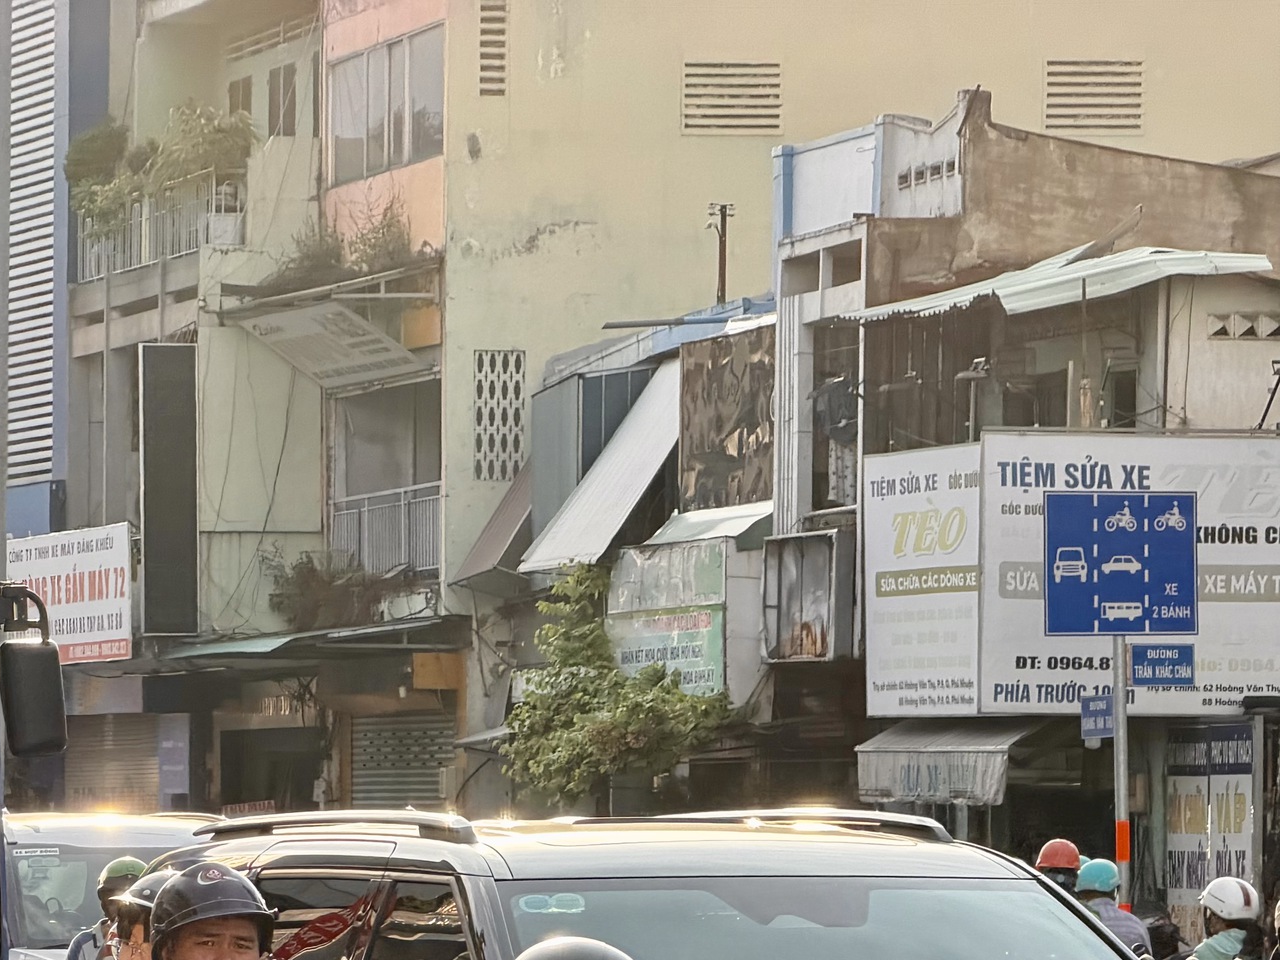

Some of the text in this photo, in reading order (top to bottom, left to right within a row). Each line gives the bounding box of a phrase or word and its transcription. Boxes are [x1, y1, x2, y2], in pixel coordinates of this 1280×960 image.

[870, 476, 896, 500] TIỆM
[899, 470, 921, 495] SỬA
[924, 473, 938, 492] XE
[997, 455, 1151, 493] TIỆM SỬA XE
[891, 497, 967, 559] TÈO
[51, 544, 59, 558] XE
[50, 575, 62, 606] XE
[88, 564, 111, 602] MÁY
[113, 566, 126, 599] 72
[921, 572, 940, 588] CÁC
[940, 570, 964, 587] DÒNG
[965, 572, 977, 586] XE
[1005, 563, 1040, 591] SỬA
[1204, 574, 1227, 594] XE
[1230, 570, 1269, 594] MÁY
[1164, 583, 1179, 596] XE
[1152, 602, 1191, 618] 2 BÁNH
[1047, 656, 1114, 670] 0964.8
[993, 680, 1031, 703] PHÍA
[1036, 680, 1087, 703] TRƯỚC
[1203, 684, 1214, 692] 62
[1215, 684, 1244, 694] Hoàng
[1246, 684, 1264, 692] Văn
